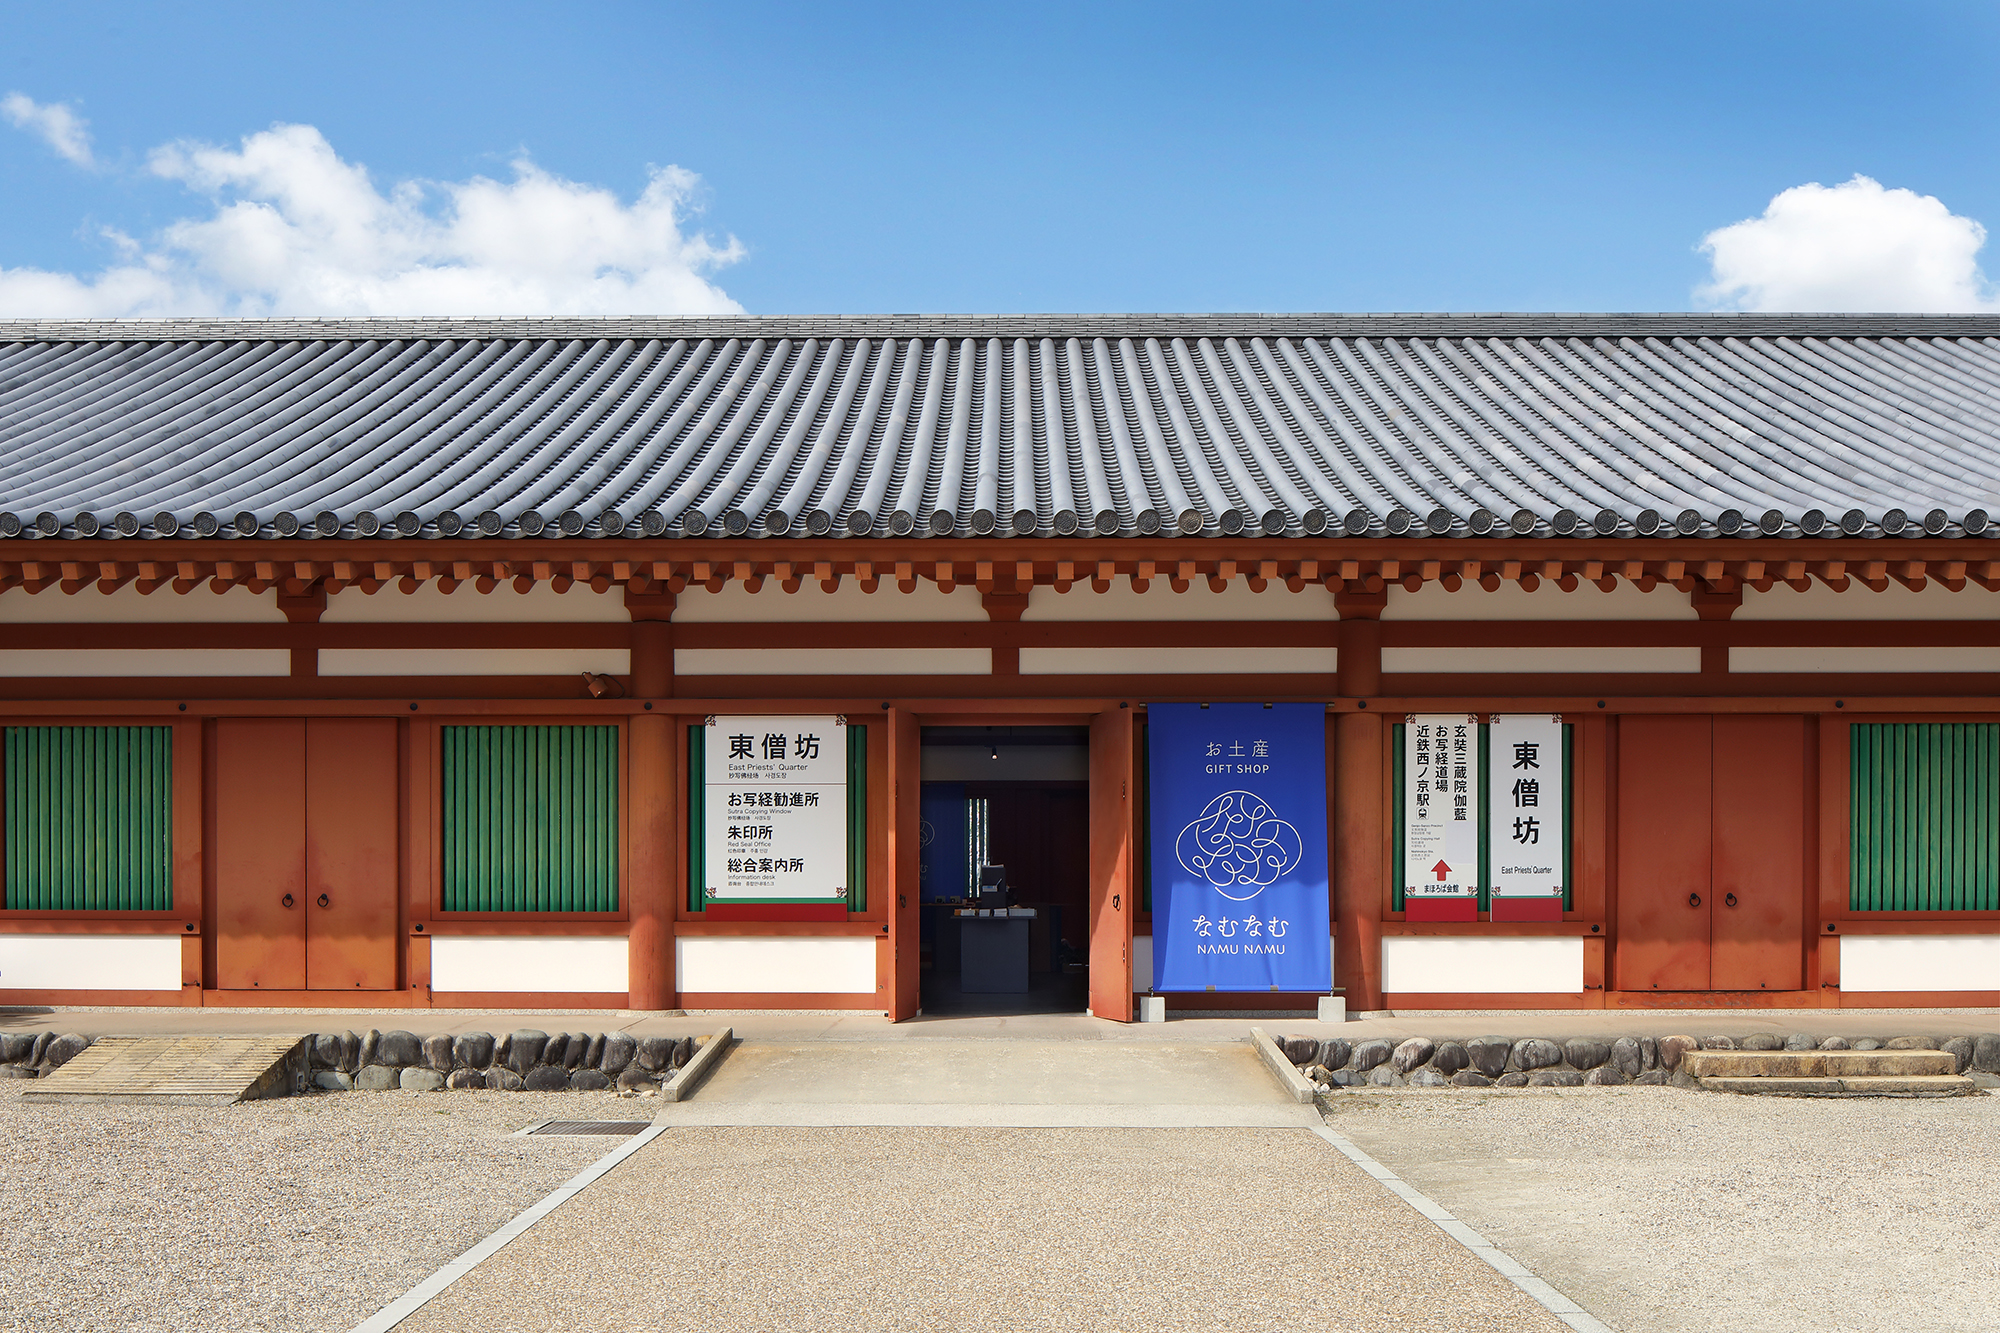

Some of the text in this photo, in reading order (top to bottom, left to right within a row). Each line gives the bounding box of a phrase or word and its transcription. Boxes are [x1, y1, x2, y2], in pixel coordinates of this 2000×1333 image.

[728, 732, 821, 760] 東僧坊
[1205, 738, 1269, 758] お土産
[1416, 724, 1430, 807] 近鉄西ノ京駅
[1434, 724, 1449, 793] お写経道場
[728, 763, 746, 771] East
[778, 763, 808, 771] Quarter
[1205, 764, 1270, 774] GIFT SHOP
[1453, 724, 1468, 821] 玄奘三蔵院伽藍
[727, 791, 820, 808] お写経勧進所
[1511, 740, 1541, 845] 東僧坊
[744, 808, 768, 816] Copying
[727, 824, 773, 840] 朱印所
[727, 857, 804, 873] 総合案内所
[1501, 864, 1513, 874] East
[1533, 864, 1553, 874] Quarter
[1423, 883, 1460, 894] まほろば会館
[1192, 914, 1290, 938] なむなむ
[1197, 944, 1286, 955] NAMU NAMU
